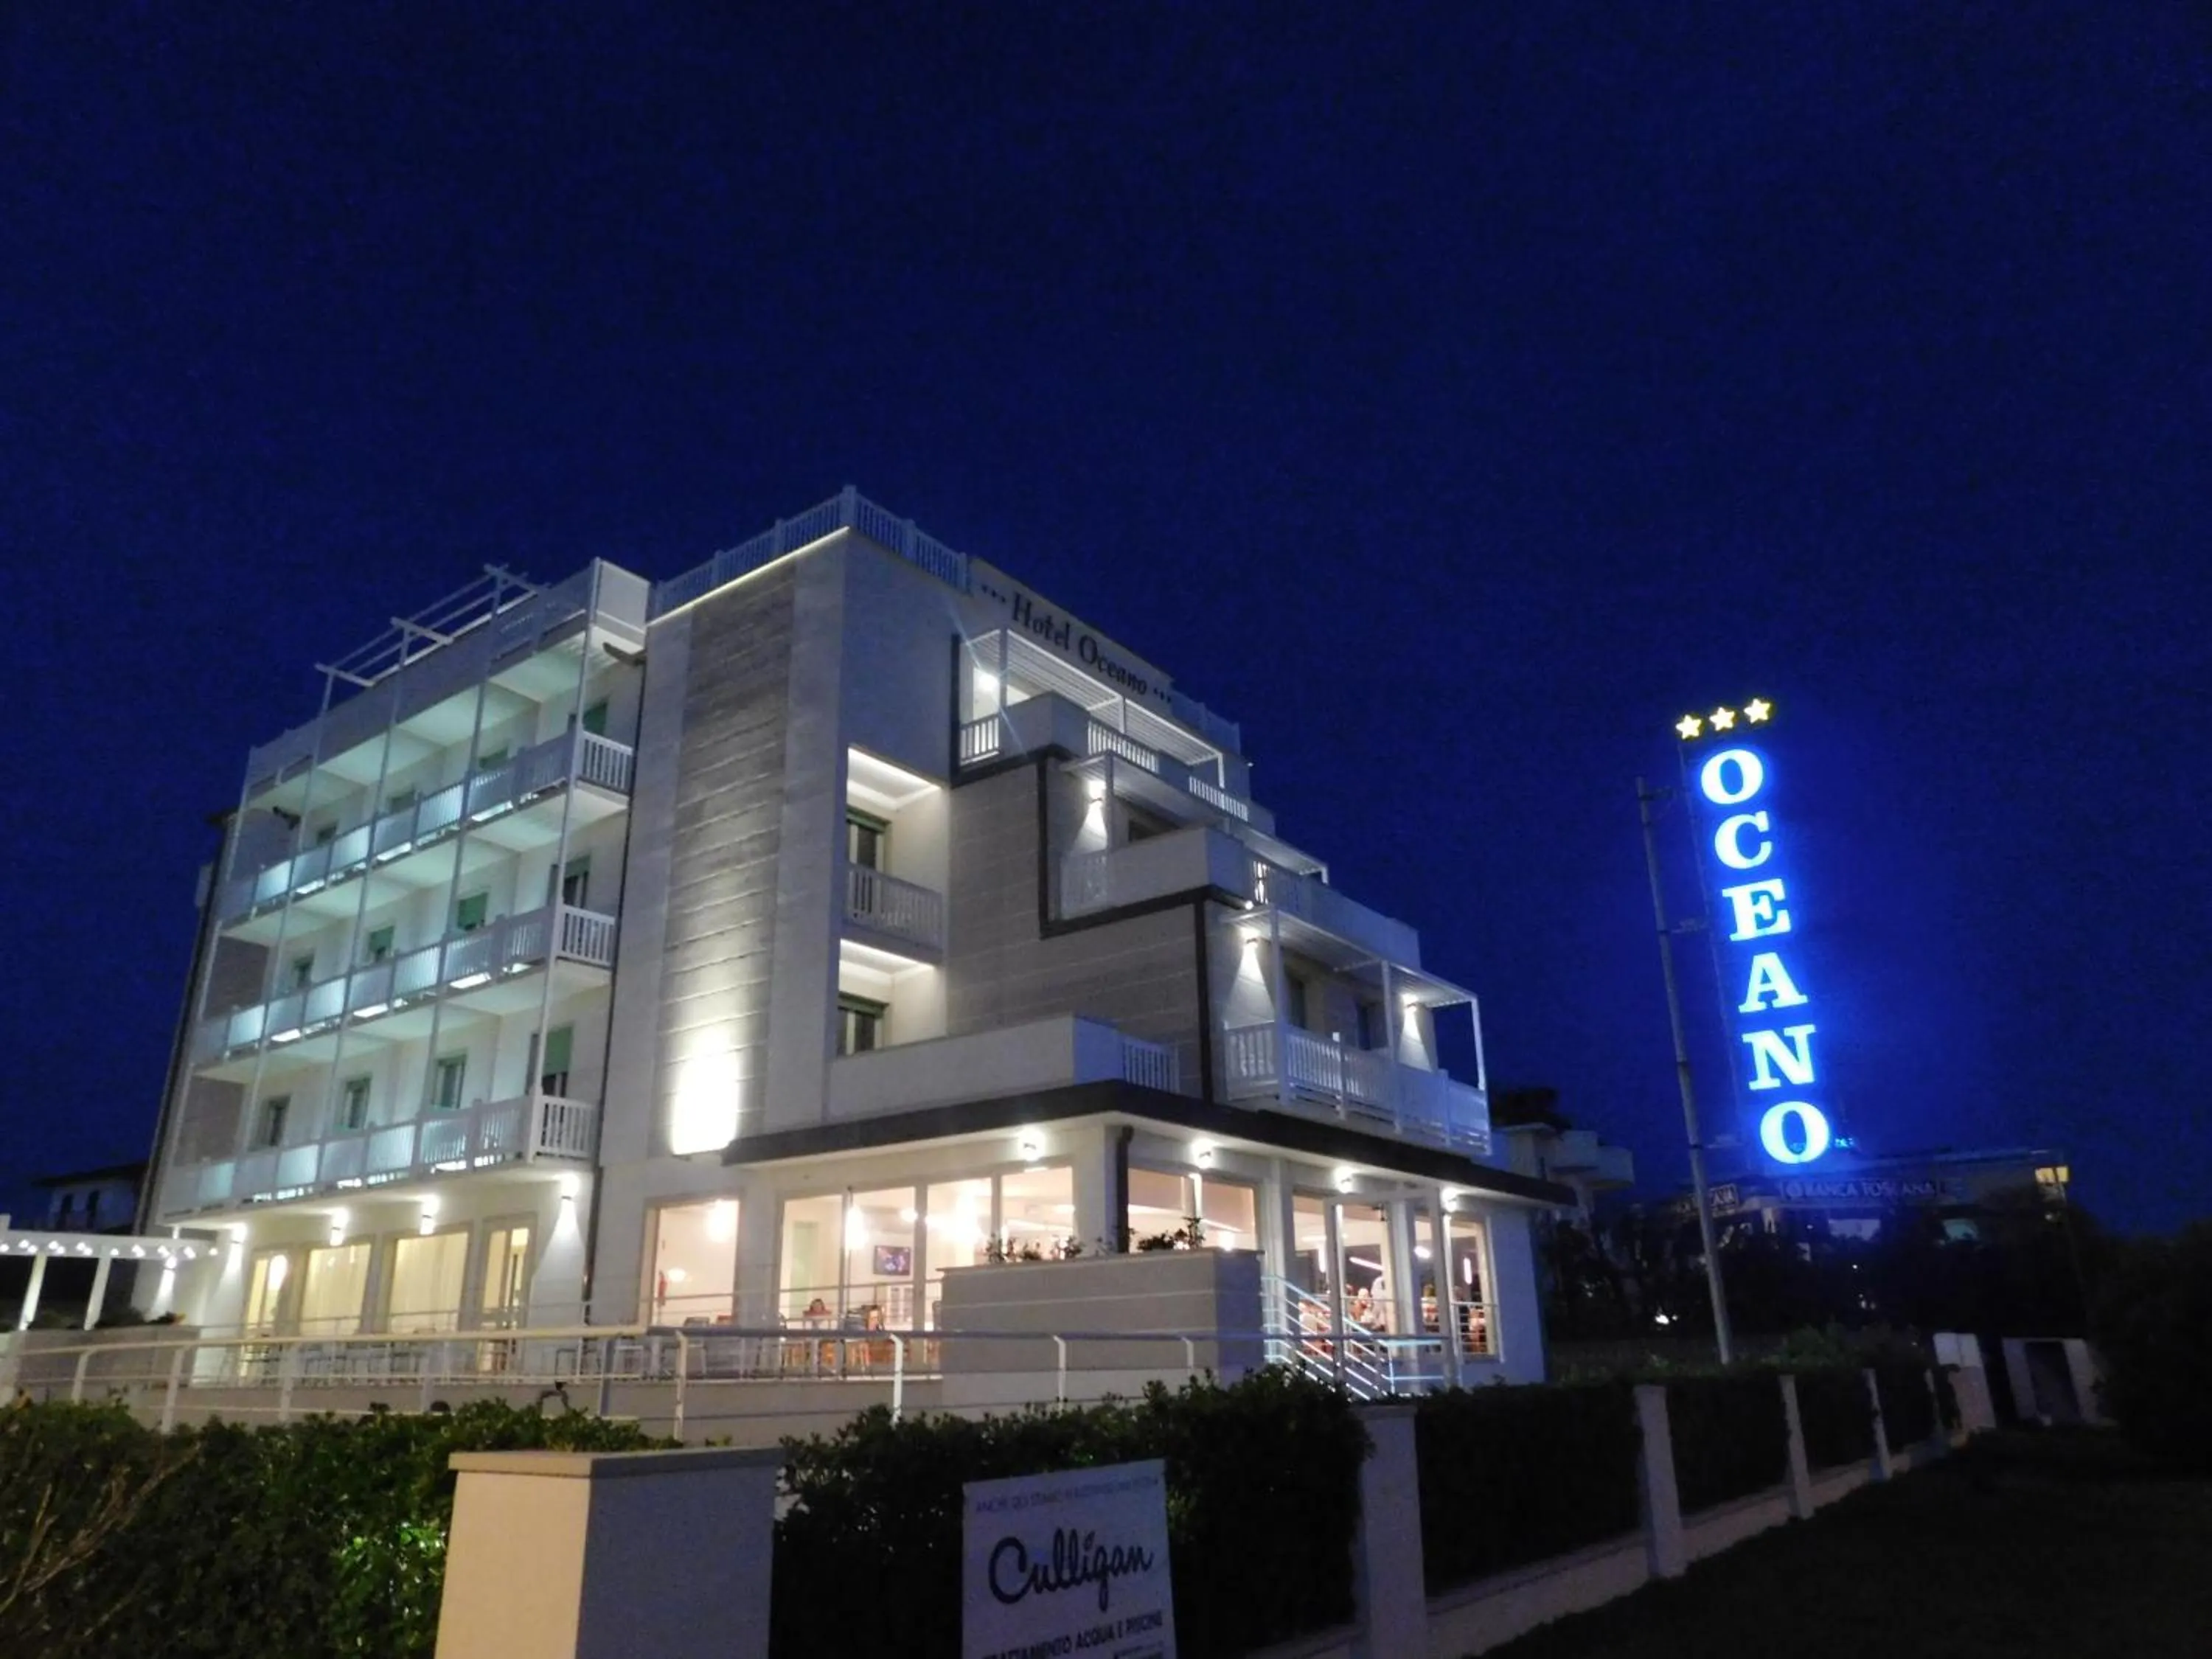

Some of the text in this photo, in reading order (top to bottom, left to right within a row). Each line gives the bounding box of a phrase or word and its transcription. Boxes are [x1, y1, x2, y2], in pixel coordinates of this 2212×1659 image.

[1011, 591, 1148, 695] Hotel Oceano
[1701, 748, 1831, 1164] OCEANO
[1861, 1181, 1935, 1197] TOSANA
[989, 1528, 1154, 1613] Culligan
[981, 1635, 1072, 1659] ATTAMENTO
